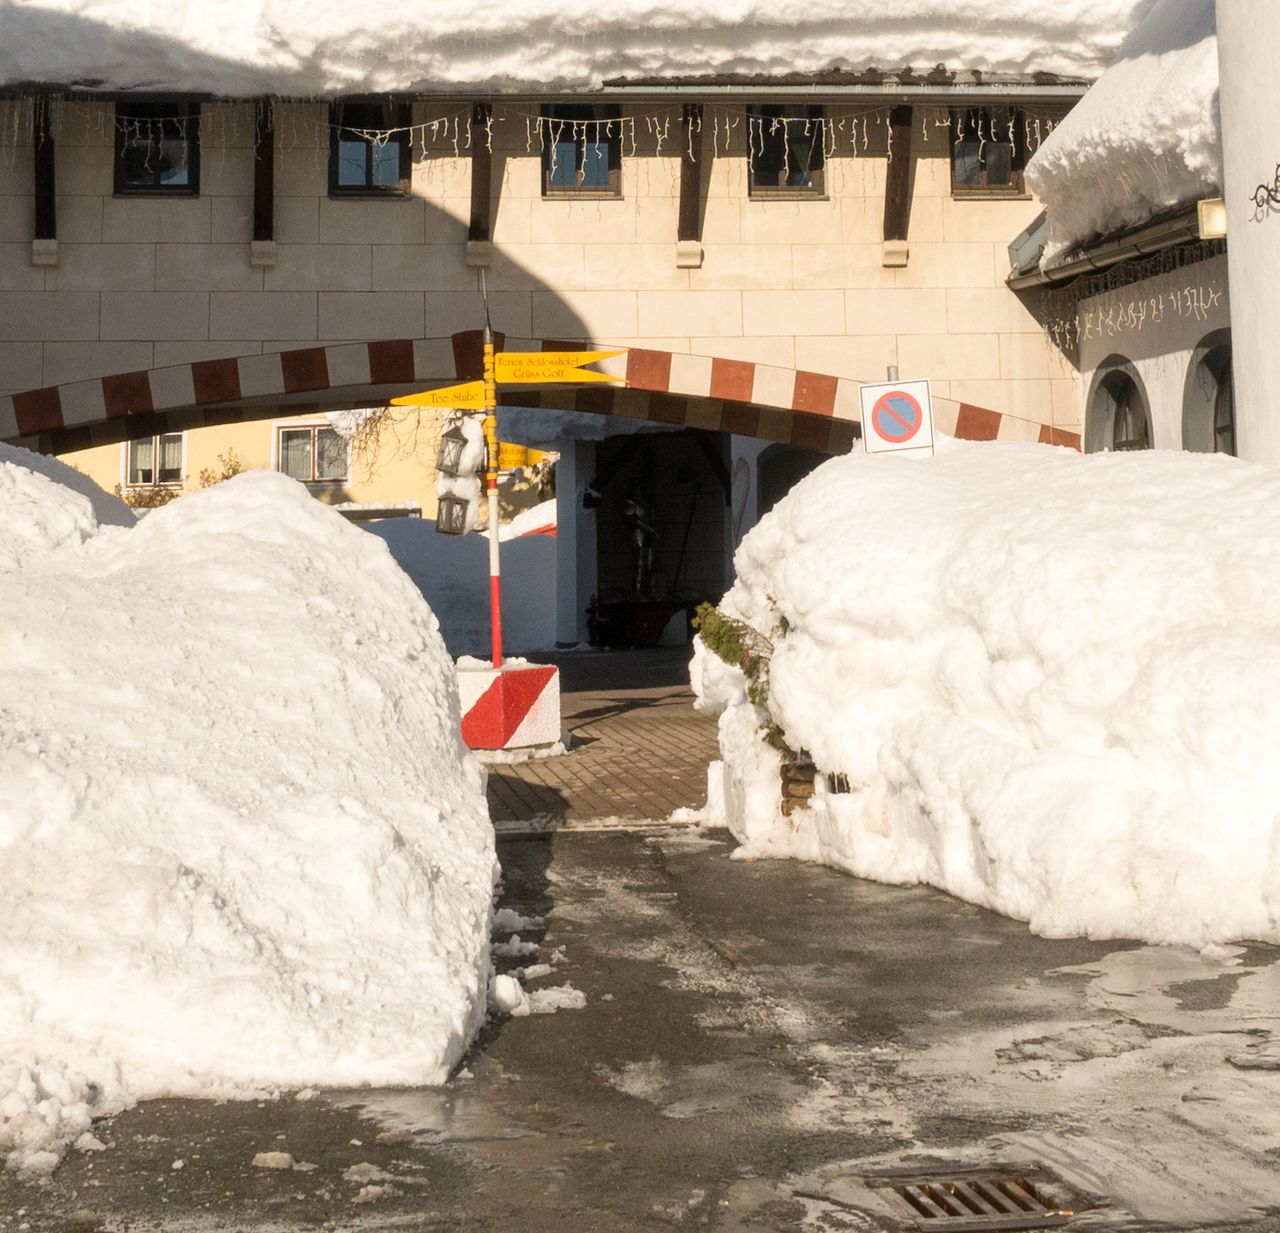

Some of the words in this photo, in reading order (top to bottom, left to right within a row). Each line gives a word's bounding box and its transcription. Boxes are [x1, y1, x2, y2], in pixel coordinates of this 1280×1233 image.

[526, 356, 579, 367] Schlosshotel
[542, 368, 565, 378] Gott
[430, 393, 449, 404] Tee
[451, 391, 479, 403] Stube
